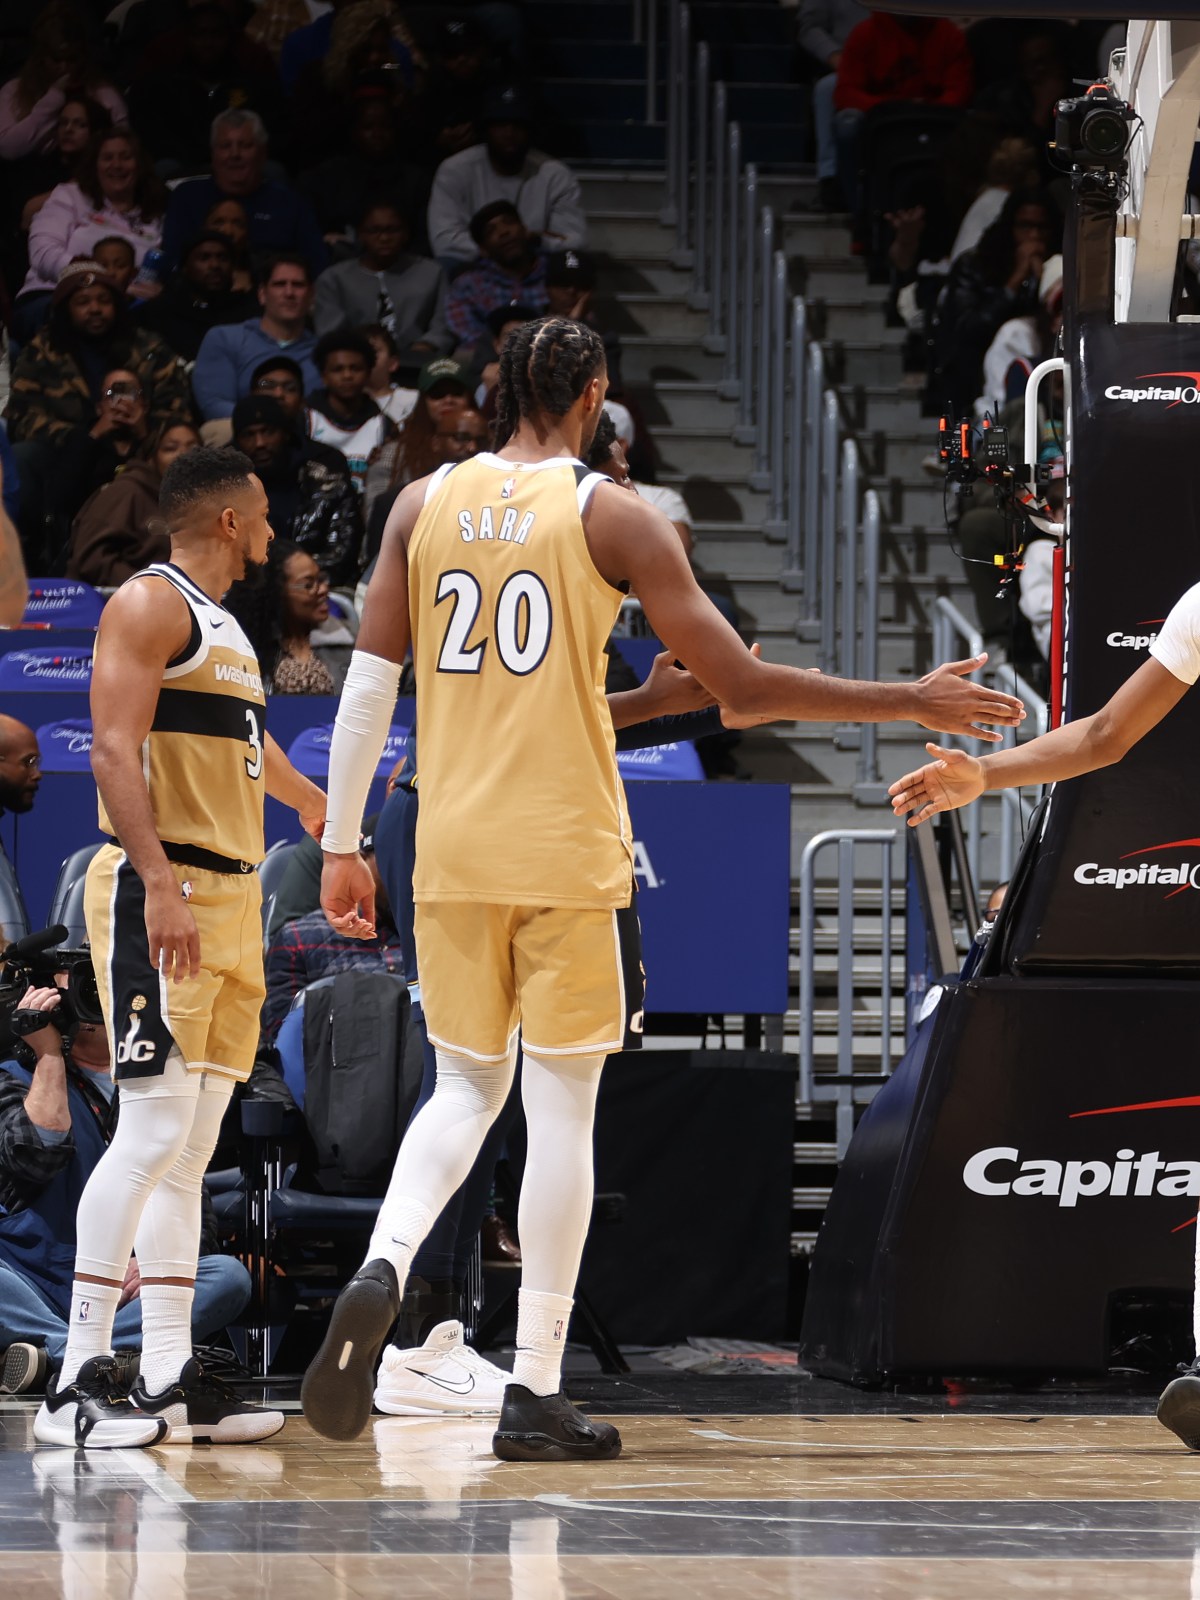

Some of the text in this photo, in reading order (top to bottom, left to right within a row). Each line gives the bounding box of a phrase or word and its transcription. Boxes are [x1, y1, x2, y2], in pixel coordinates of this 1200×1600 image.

[457, 506, 536, 545] SARR
[434, 568, 553, 677] 20
[243, 708, 263, 780] 3
